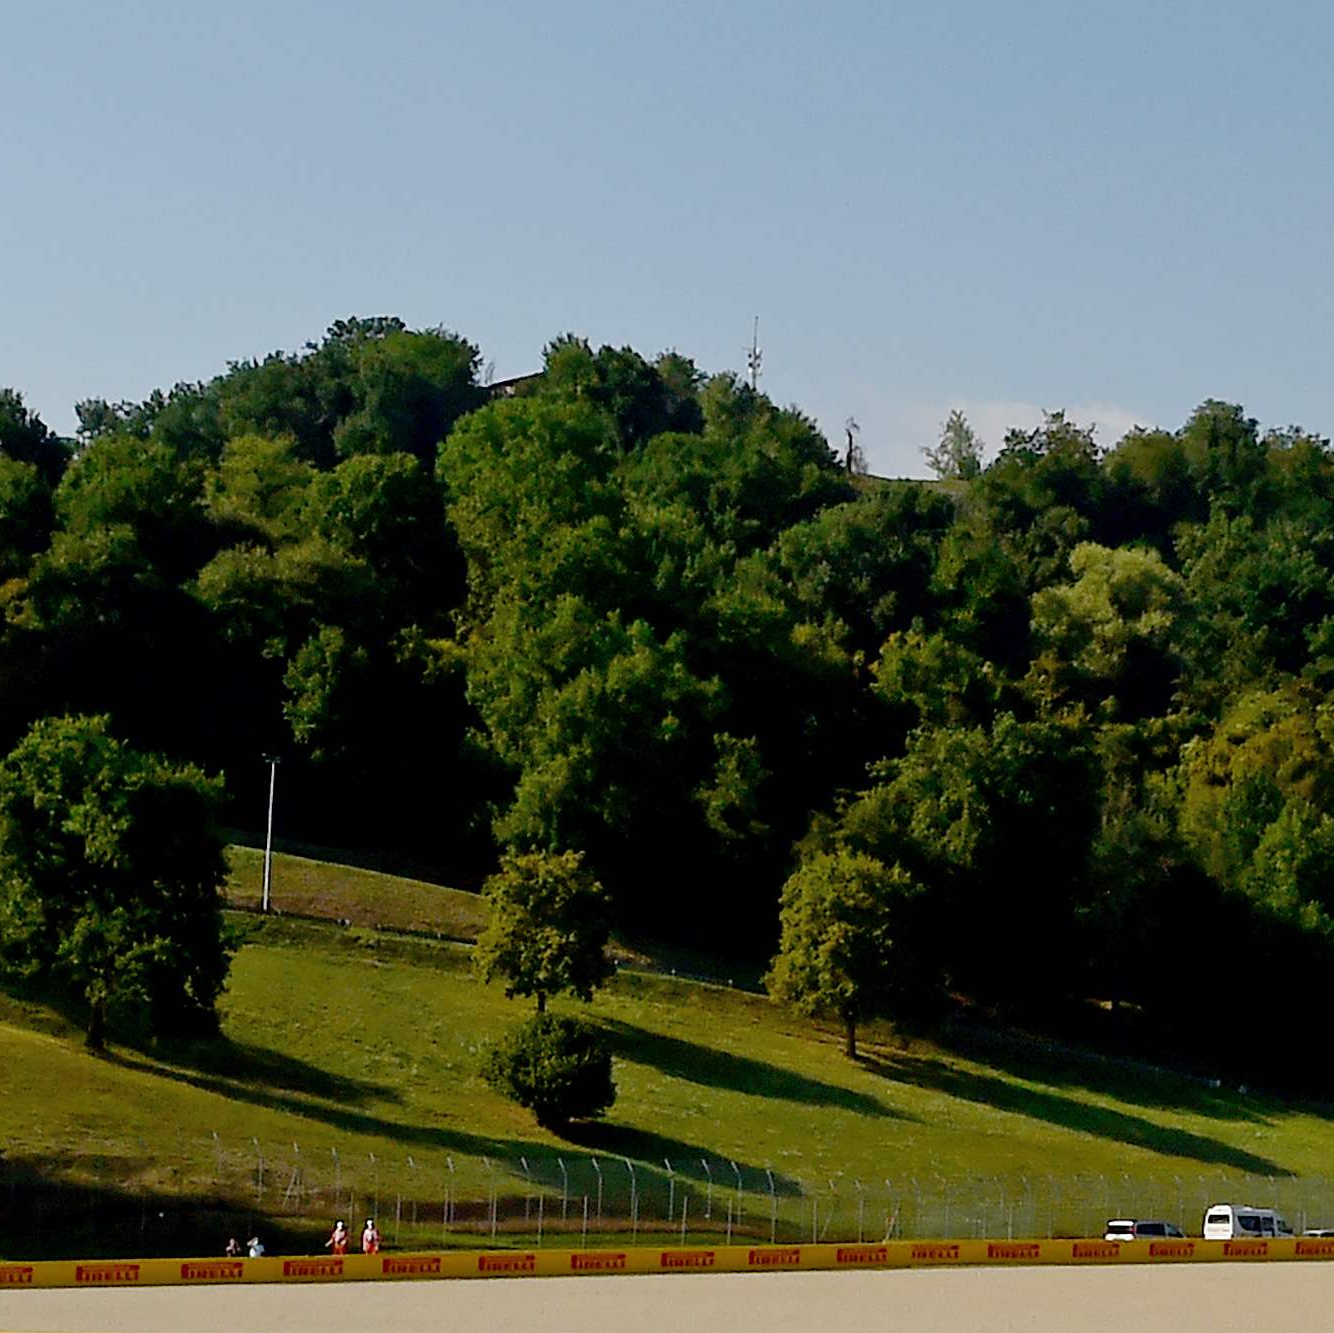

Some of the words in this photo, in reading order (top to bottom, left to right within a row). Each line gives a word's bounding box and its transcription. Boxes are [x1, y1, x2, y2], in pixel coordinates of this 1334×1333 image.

[180, 1262, 244, 1280] PIRELLI
[283, 1259, 344, 1276] PIRELLI
[382, 1257, 442, 1274] PIRELLI
[478, 1254, 536, 1272] PIRELLI
